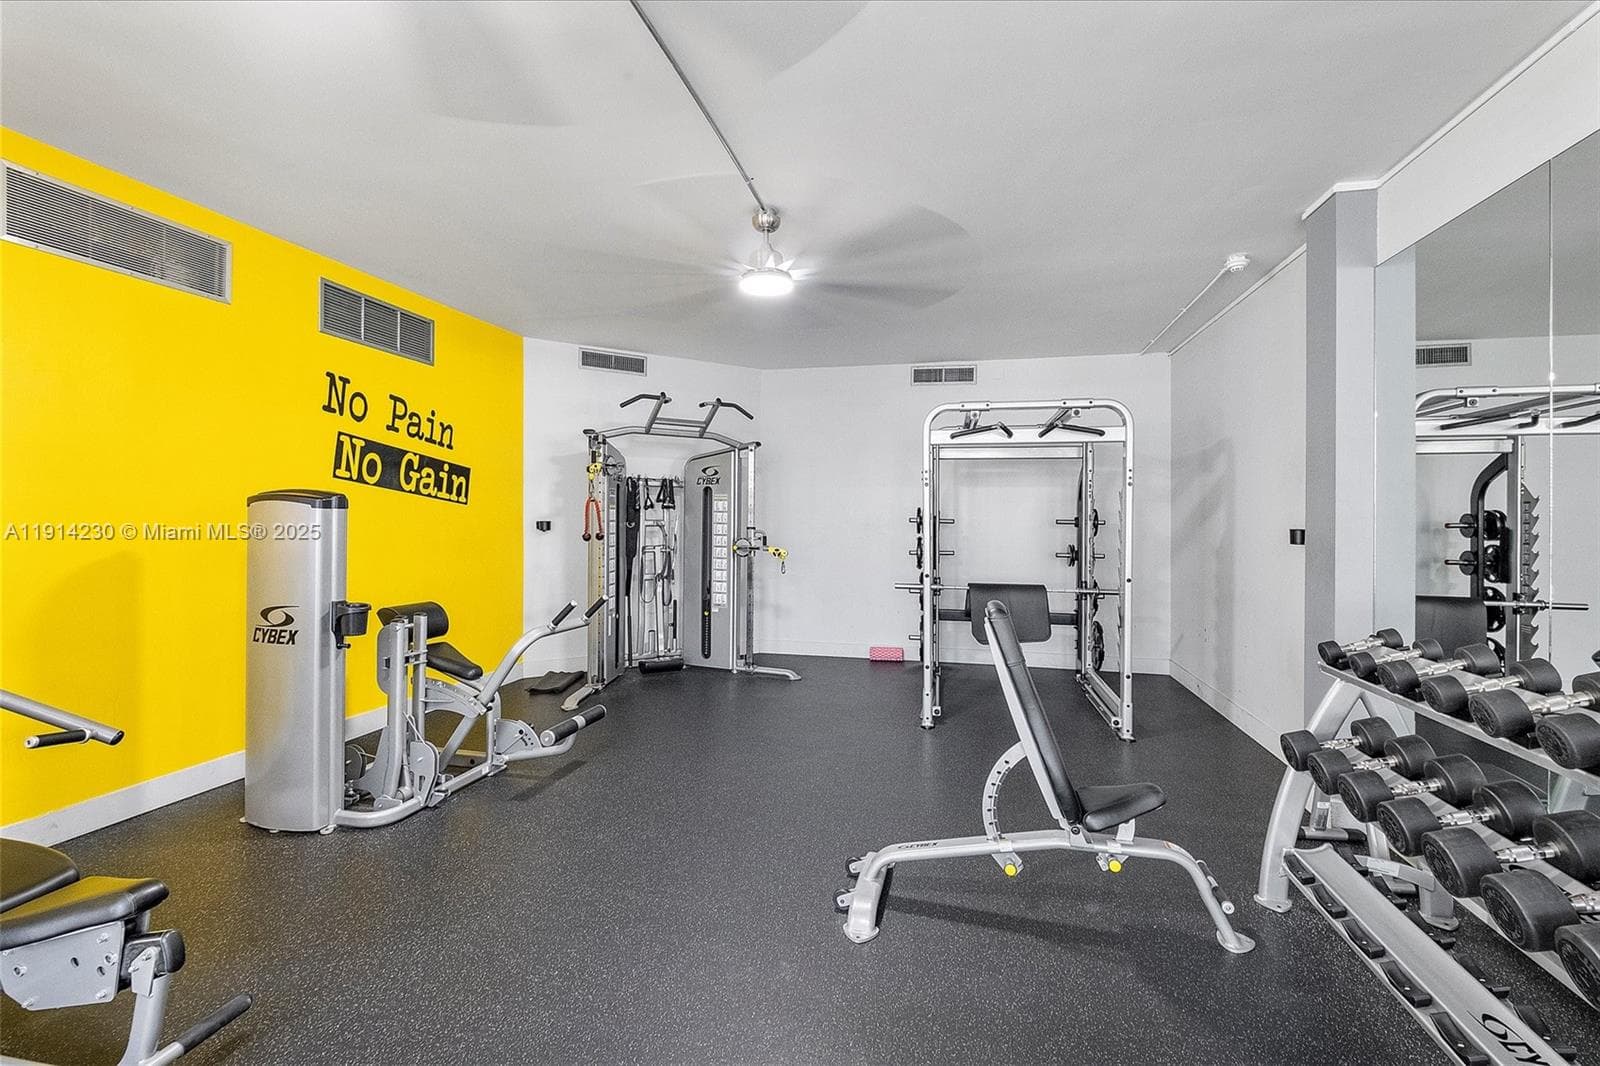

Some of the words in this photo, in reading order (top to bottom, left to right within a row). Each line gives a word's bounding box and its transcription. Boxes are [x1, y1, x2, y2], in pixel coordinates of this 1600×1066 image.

[322, 371, 369, 423] No
[386, 394, 454, 450] Pain
[335, 434, 383, 485] No
[400, 452, 468, 504] Gain
[696, 477, 721, 486] CYBEX
[252, 627, 300, 645] CYBEX
